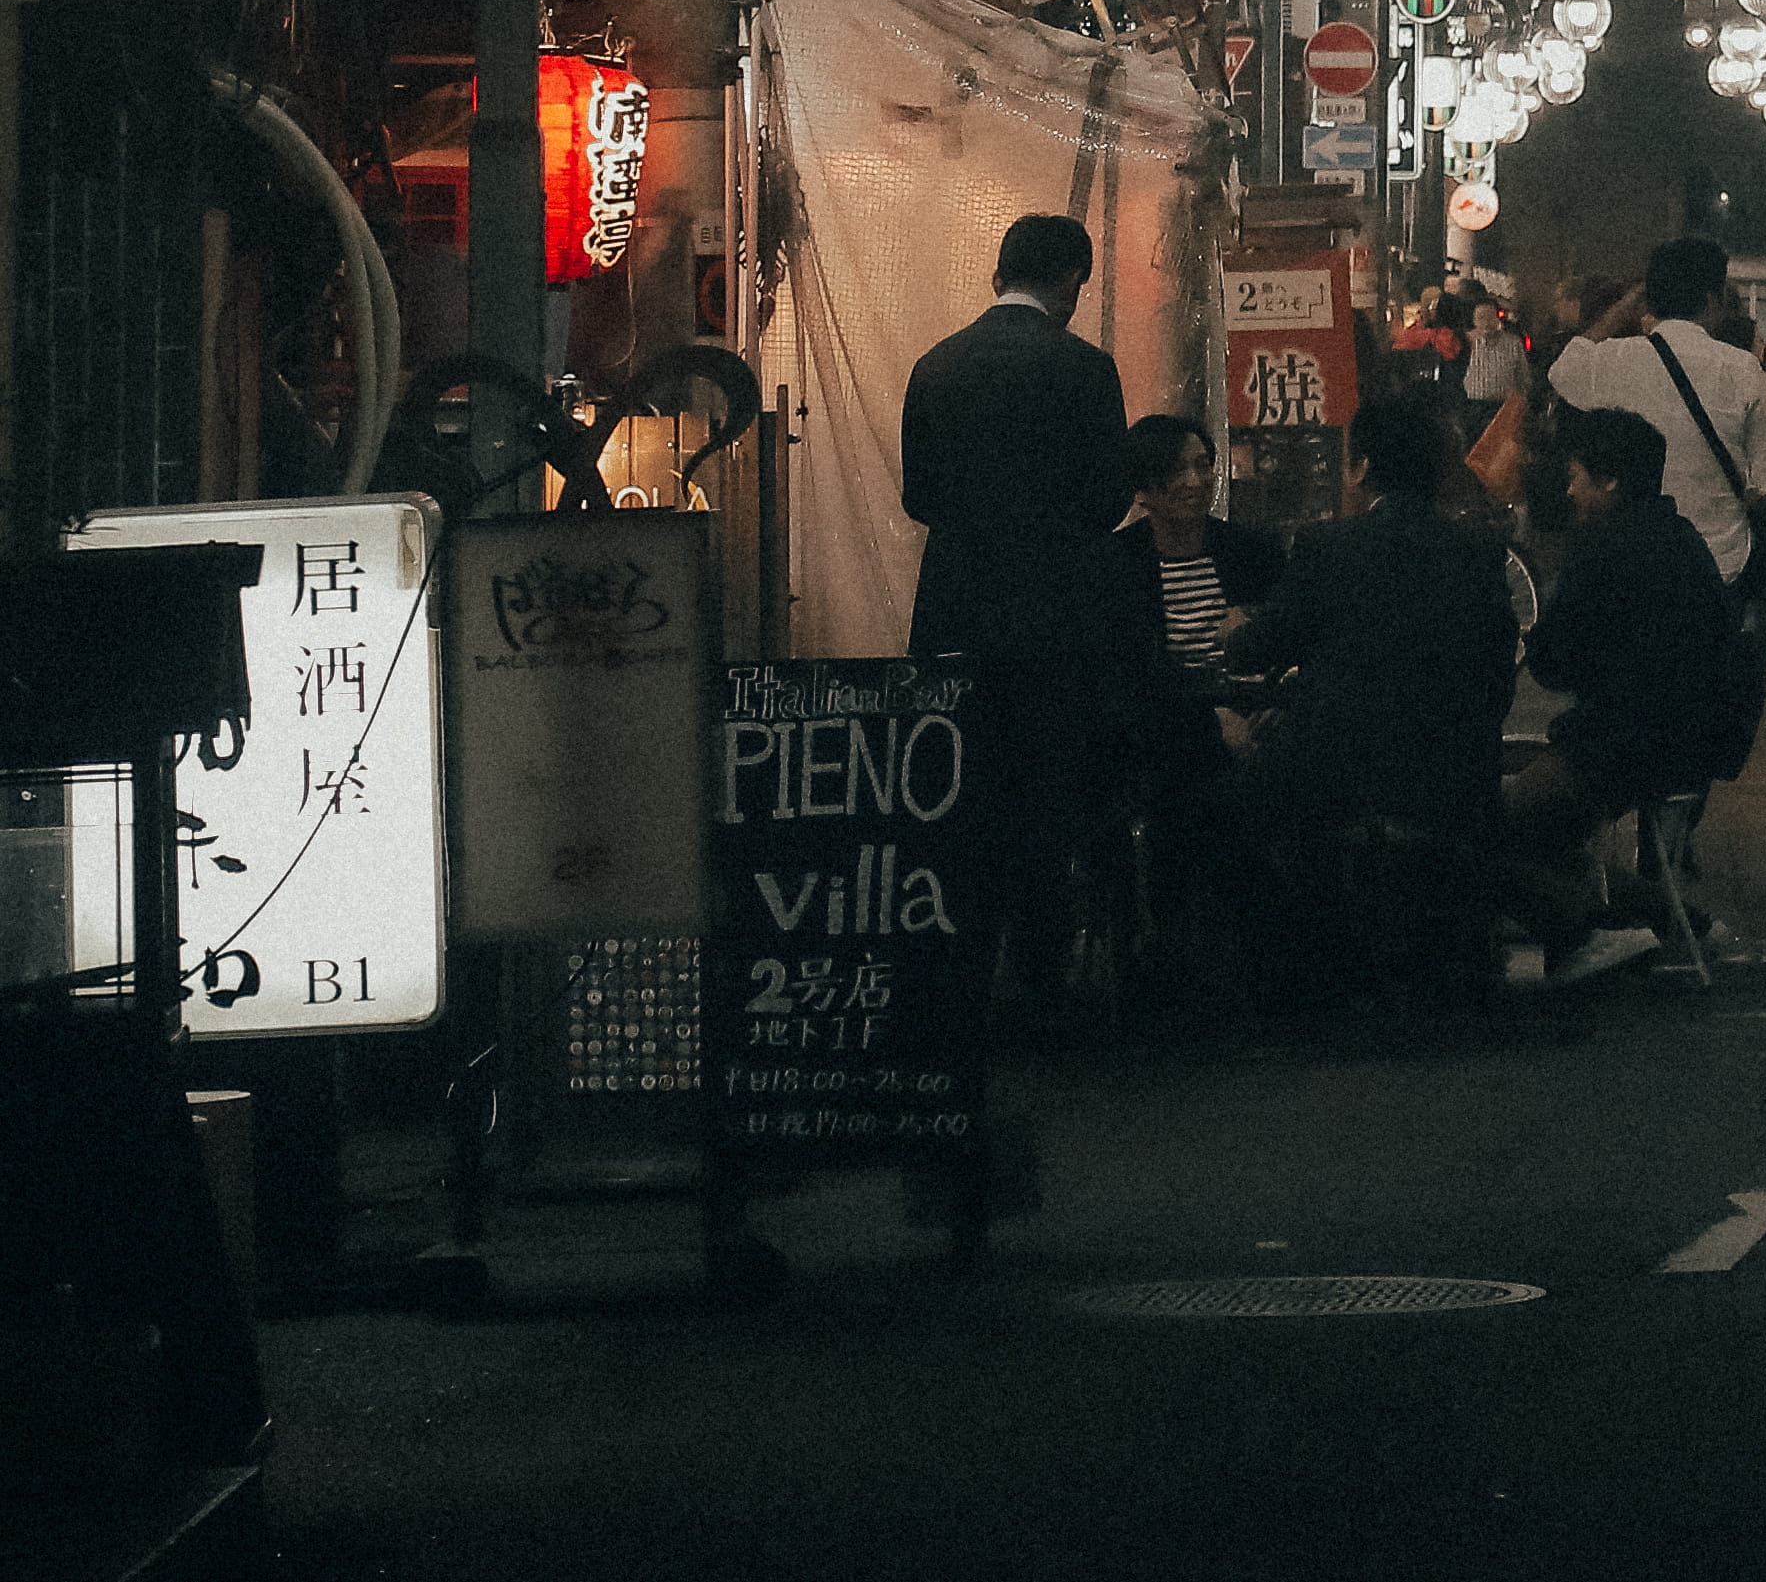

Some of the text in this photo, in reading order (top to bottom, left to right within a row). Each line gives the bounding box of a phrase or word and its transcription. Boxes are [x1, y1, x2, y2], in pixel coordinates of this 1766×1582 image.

[290, 538, 371, 817] 居酒屋
[718, 713, 963, 824] PIENO
[302, 956, 376, 1006] B1
[744, 951, 894, 1014] 2号店
